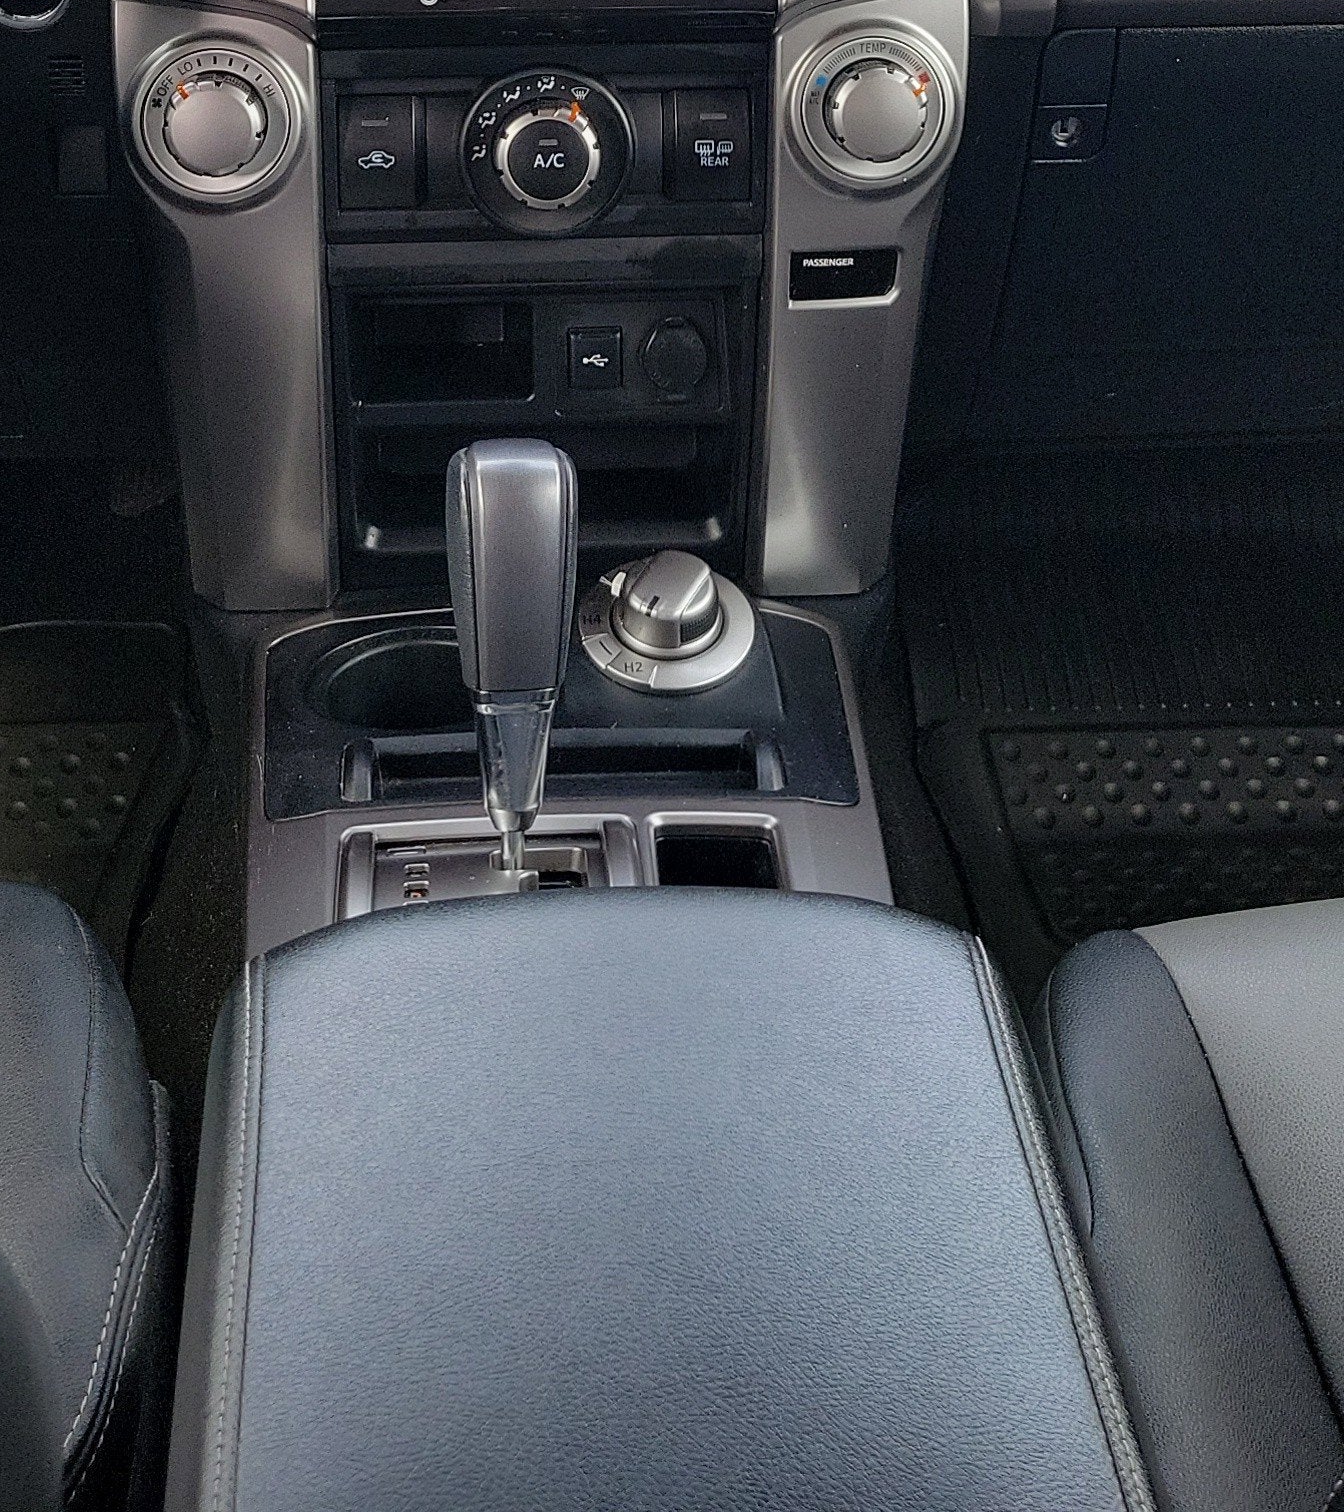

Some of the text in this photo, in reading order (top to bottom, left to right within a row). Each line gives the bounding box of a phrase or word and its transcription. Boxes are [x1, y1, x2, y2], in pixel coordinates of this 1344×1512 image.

[859, 42, 886, 53] TEMP
[177, 61, 193, 76] LO
[156, 74, 174, 97] OFF
[263, 83, 276, 97] HI
[533, 152, 565, 168] A/C
[700, 156, 729, 167] REAR
[802, 257, 854, 267] PASSENGER
[624, 661, 643, 673] H2
